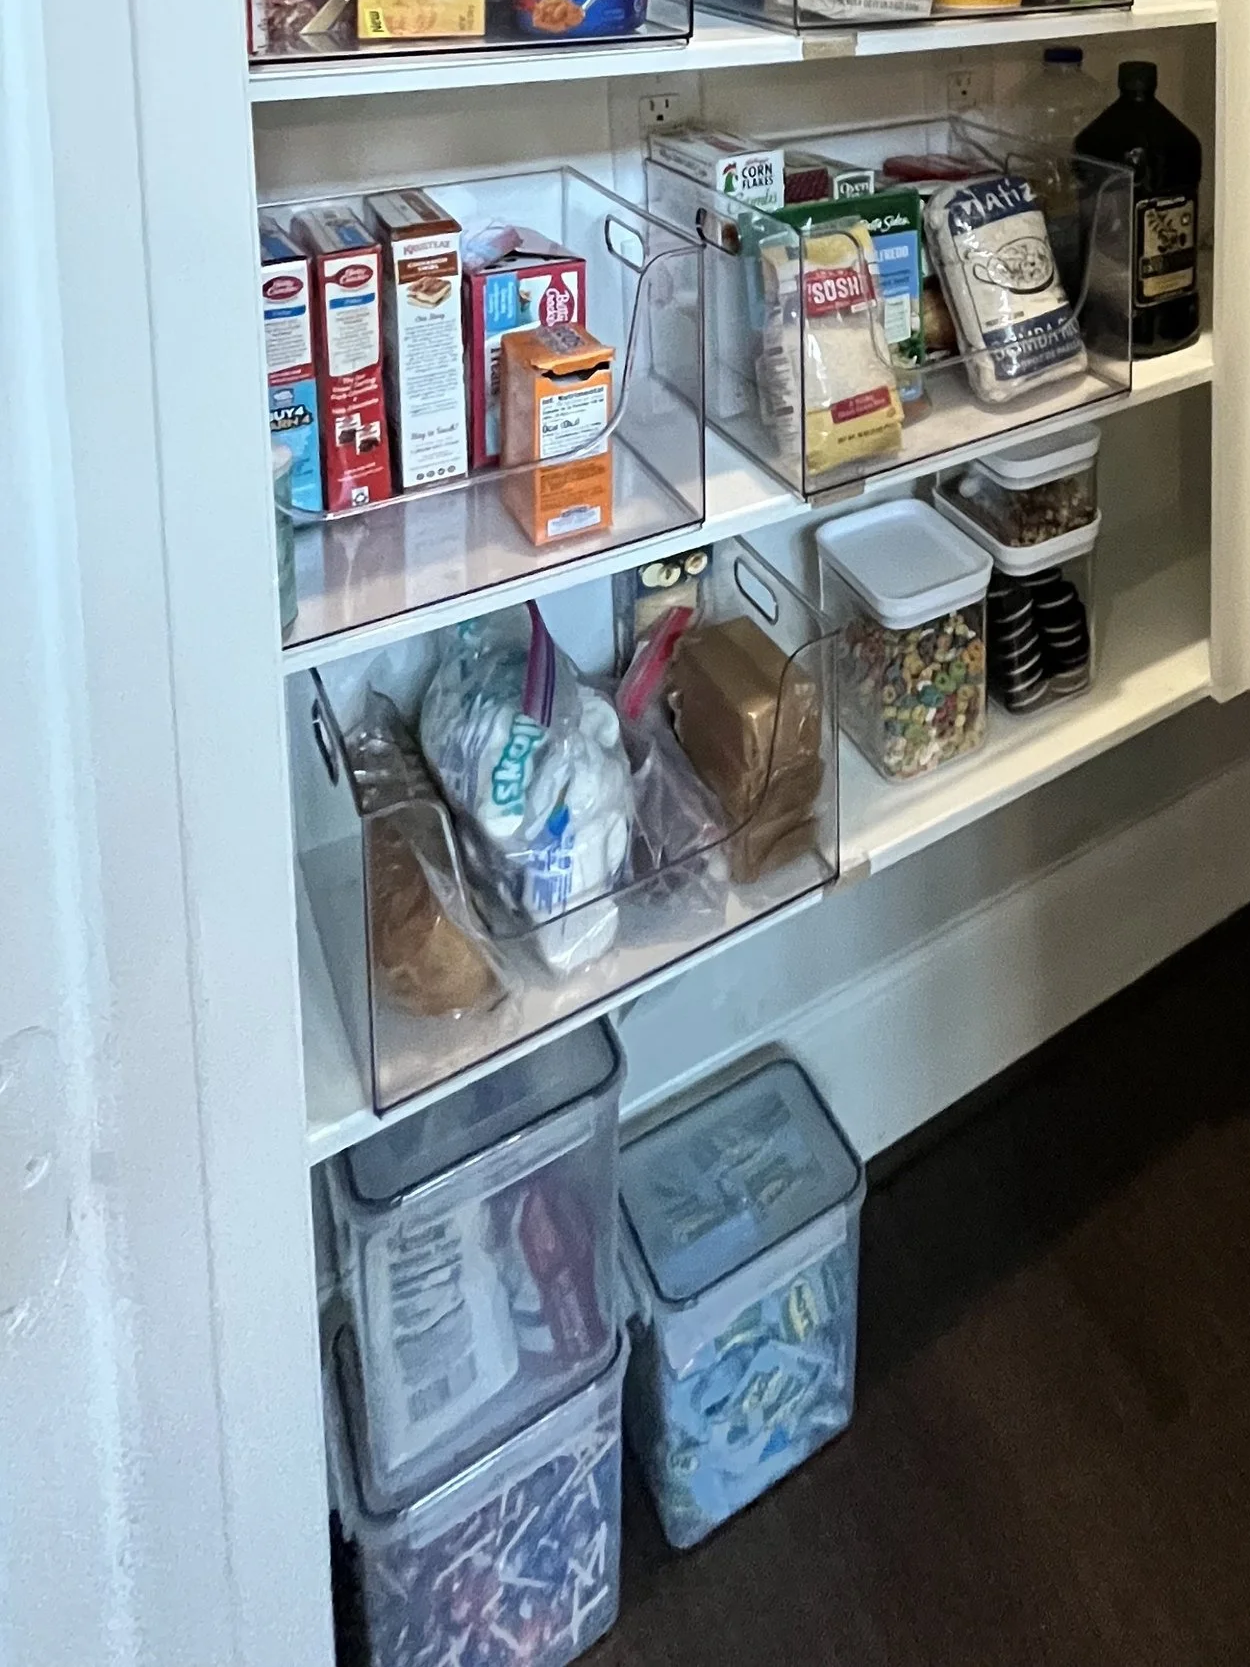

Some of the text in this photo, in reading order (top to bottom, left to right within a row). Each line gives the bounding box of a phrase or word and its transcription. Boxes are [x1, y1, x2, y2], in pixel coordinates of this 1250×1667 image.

[741, 162, 773, 179] CORN
[742, 175, 774, 190] FLAKES
[839, 182, 870, 195] Oven
